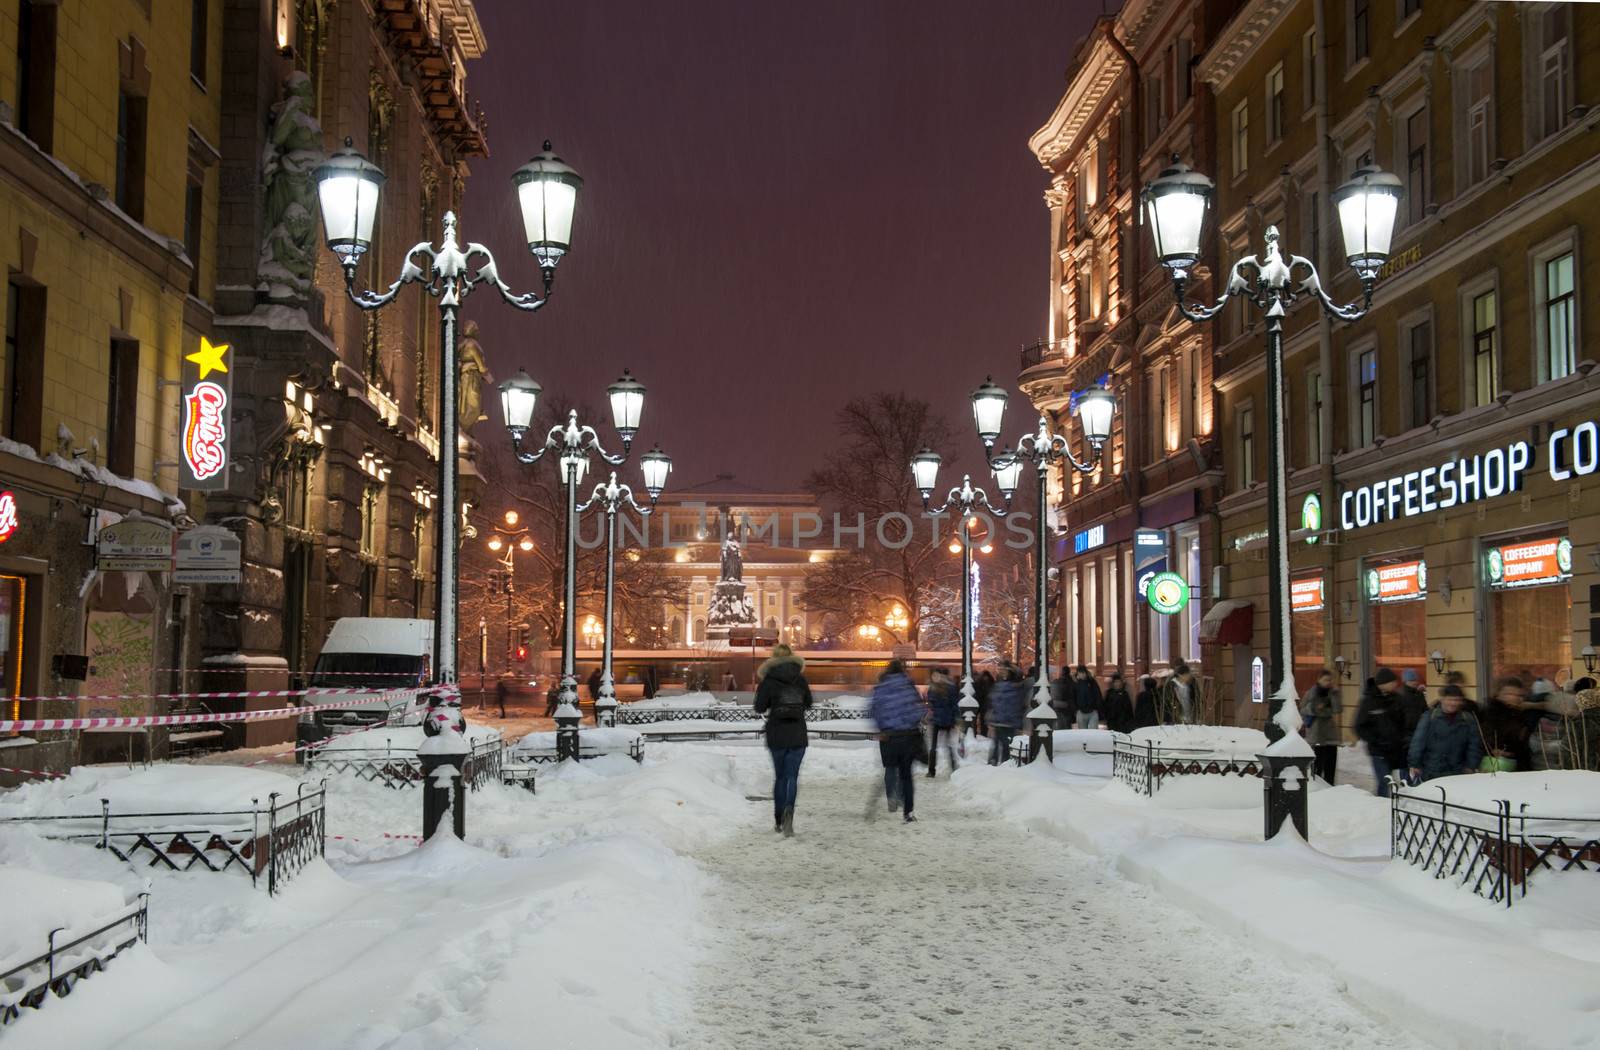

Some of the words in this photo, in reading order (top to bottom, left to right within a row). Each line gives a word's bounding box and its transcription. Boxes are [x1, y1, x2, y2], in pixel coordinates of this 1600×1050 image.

[197, 385, 224, 443] Carl's
[195, 441, 222, 477] Jr.
[1341, 441, 1528, 530] COFFEESHOP
[1549, 421, 1598, 481] CO
[1075, 530, 1088, 554] ZENIT
[1088, 524, 1104, 549] ARENA
[1504, 543, 1557, 561] COFFEESHOP
[1380, 565, 1418, 580] COFFEESHOP
[1504, 560, 1543, 576] COMPANY
[1153, 572, 1186, 588] COFFEESHOP
[1380, 579, 1408, 593] COMPANY
